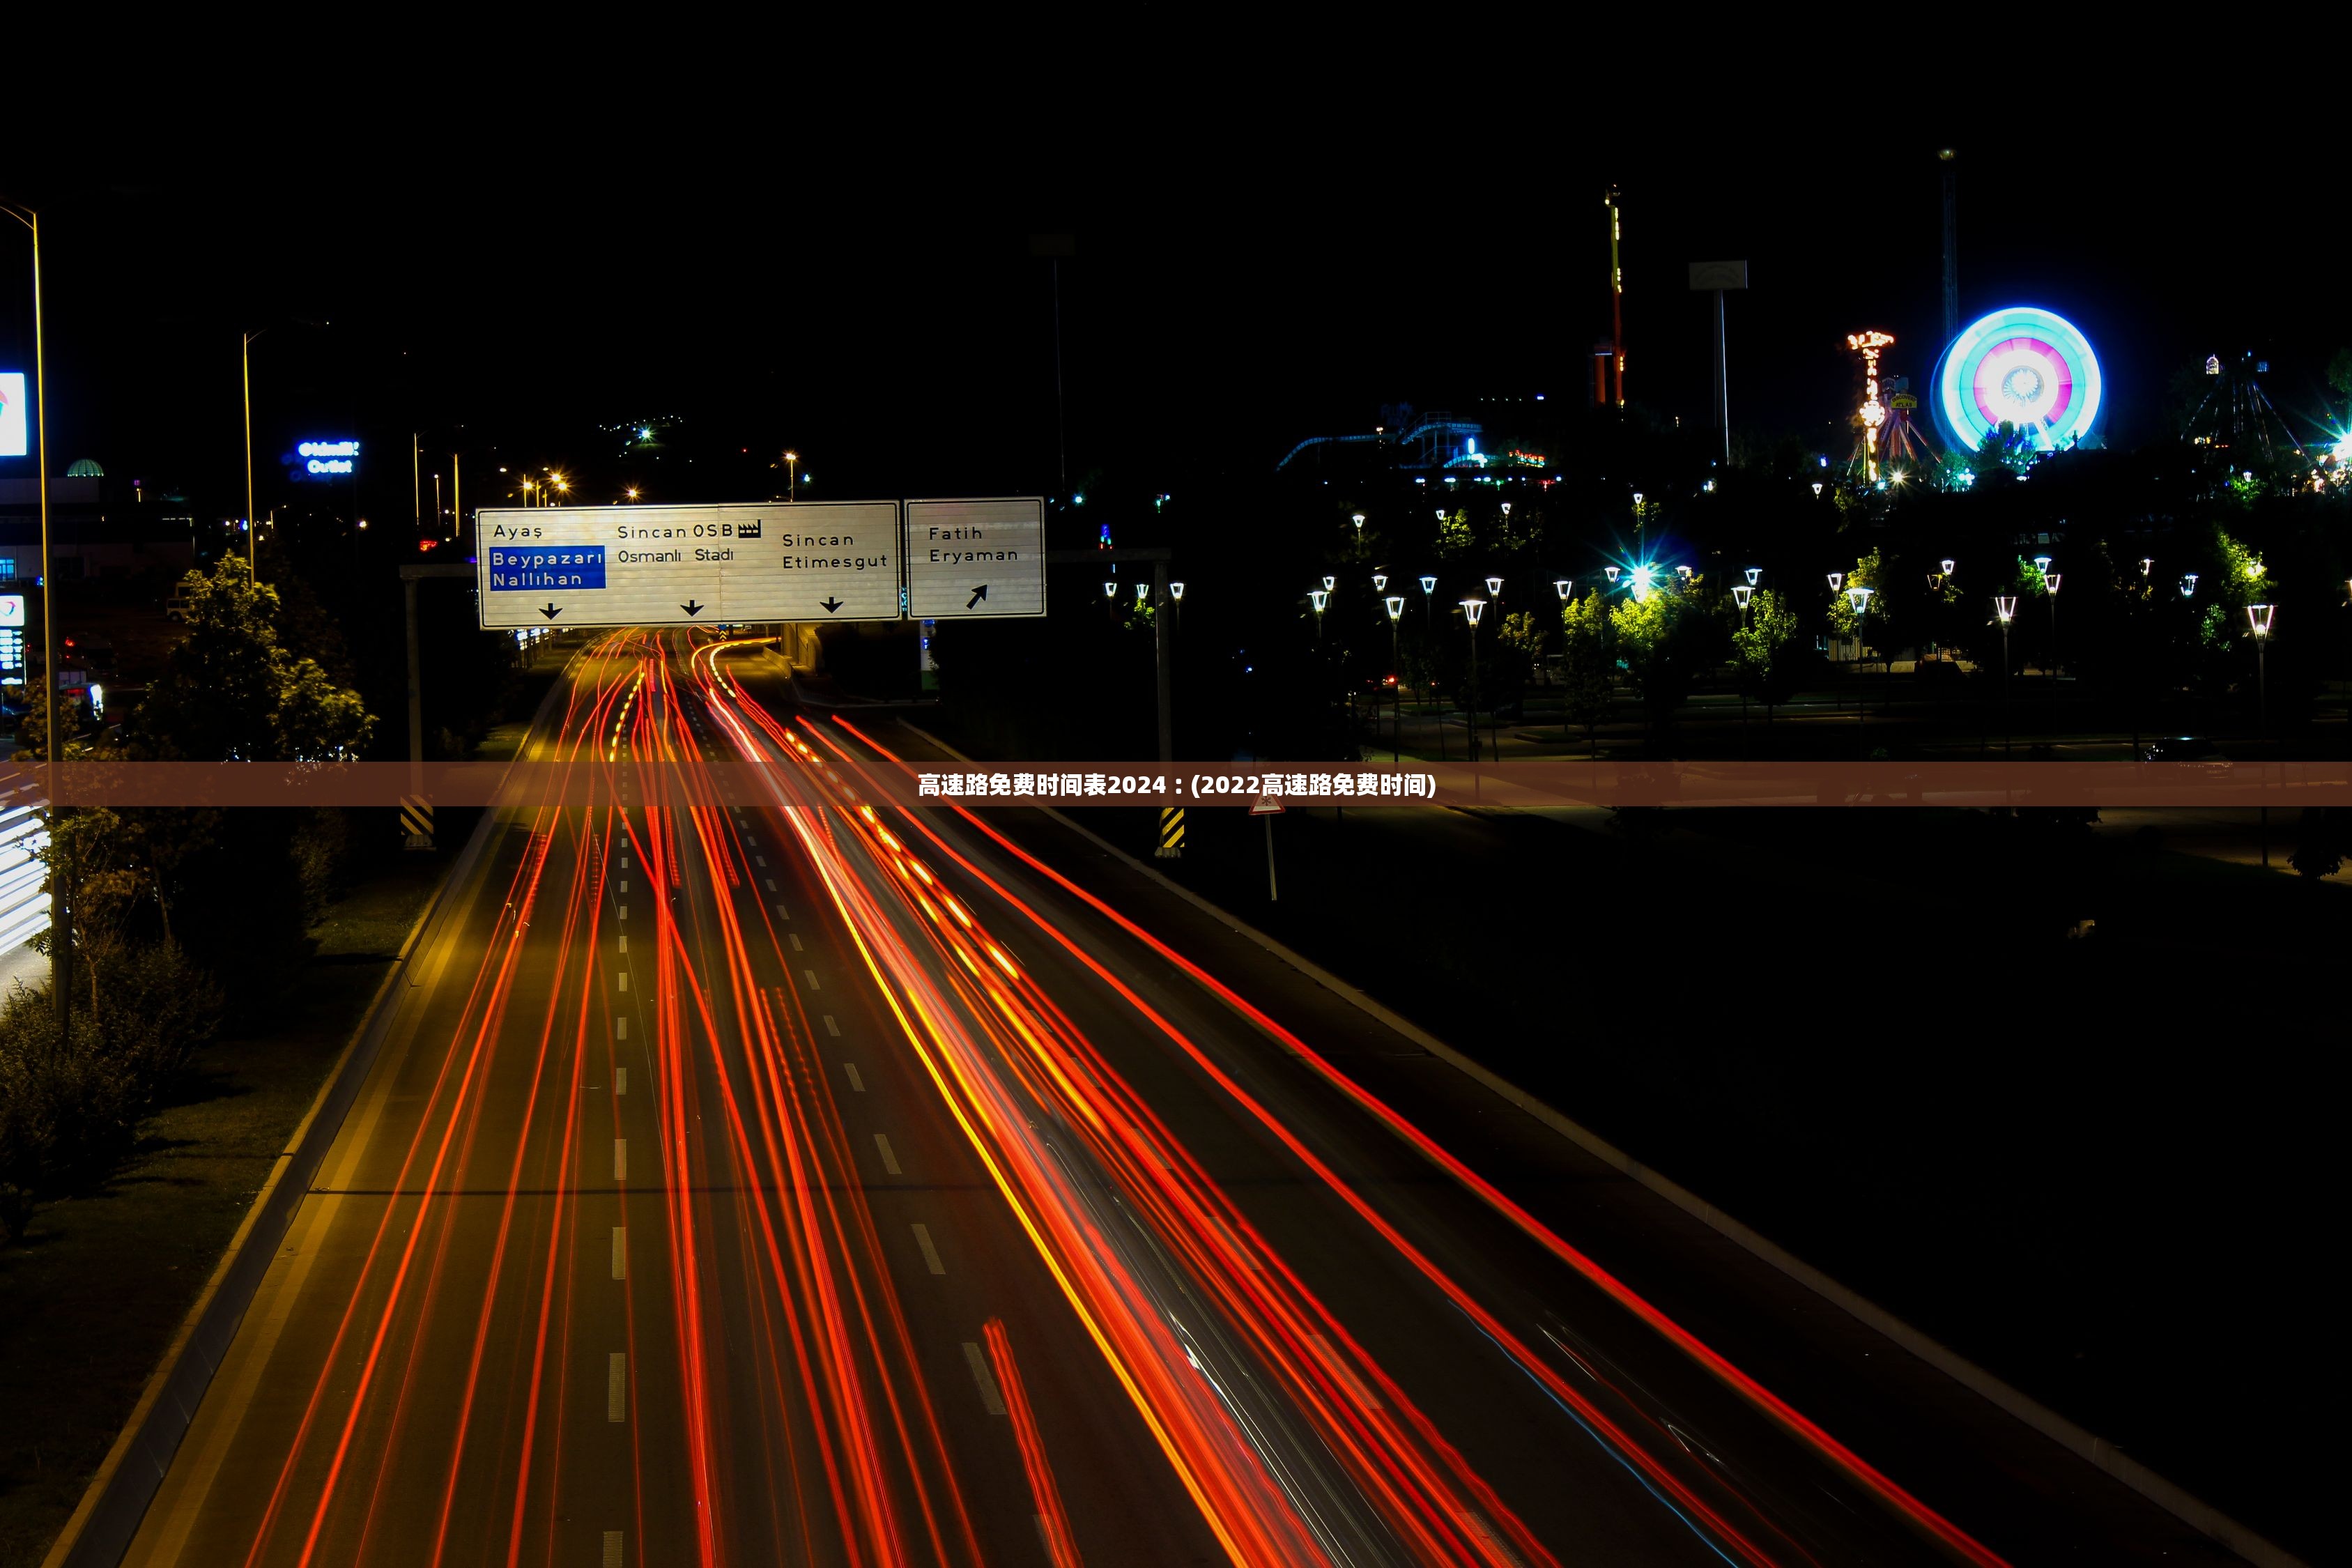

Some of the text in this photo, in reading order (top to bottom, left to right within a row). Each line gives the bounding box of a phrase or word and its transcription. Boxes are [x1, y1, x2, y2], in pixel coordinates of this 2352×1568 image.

[493, 524, 542, 540] Ayaş
[617, 523, 733, 539] Sincan OSB
[929, 526, 983, 540] Fatih
[783, 534, 854, 547] Sincan
[493, 553, 601, 569] Beypazarı
[617, 548, 734, 563] Osmanlı Stadı
[783, 555, 887, 570] Etimesgut
[930, 549, 1018, 564] Eryaman
[493, 572, 581, 586] Nallıhan
